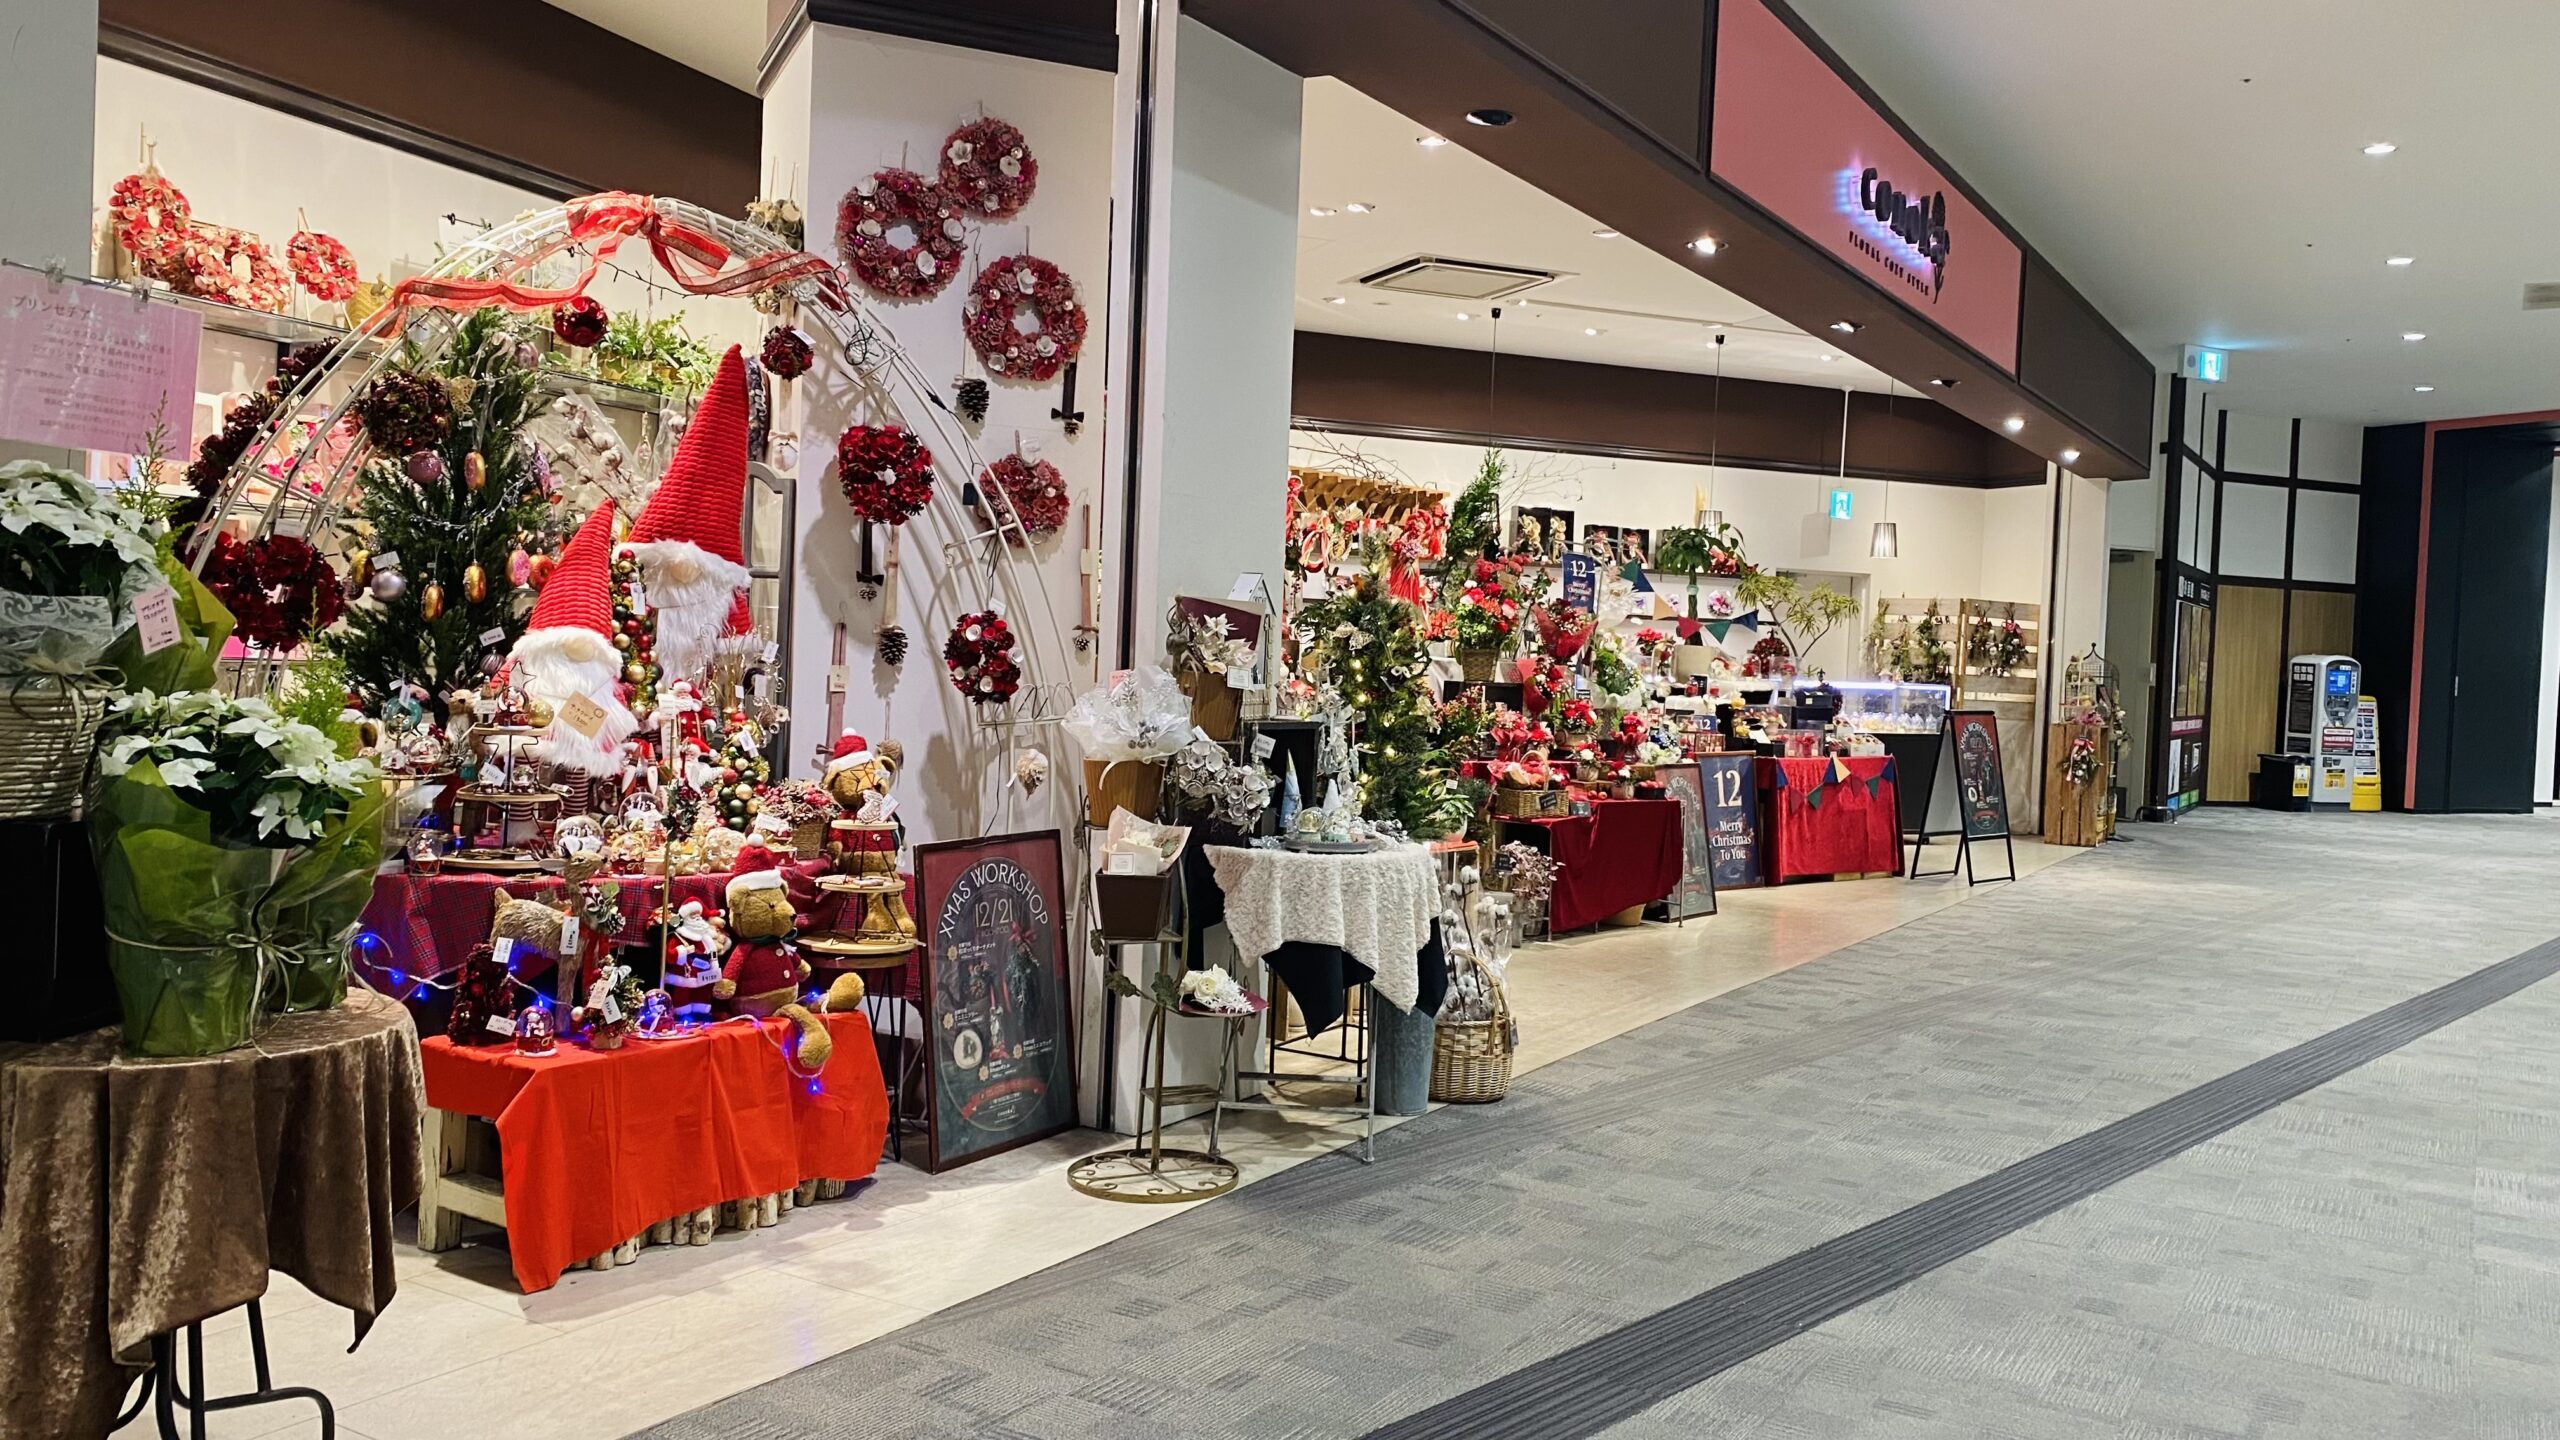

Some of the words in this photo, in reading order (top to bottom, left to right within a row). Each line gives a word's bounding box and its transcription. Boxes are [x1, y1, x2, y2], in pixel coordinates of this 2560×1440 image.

[1849, 231, 1881, 263] FLORAL
[1884, 257, 1904, 279] COZY
[1907, 273, 1929, 296] STYLE
[1571, 560, 1587, 578] 12
[1713, 770, 1742, 807] 12
[1719, 820, 1743, 834] Merry
[1712, 835, 1751, 847] Christmas
[1720, 849, 1731, 861] To
[1731, 848, 1746, 860] You
[939, 880, 971, 939] XMAS
[970, 863, 1048, 925] WORKSHOP
[975, 898, 1013, 928] 12/21
